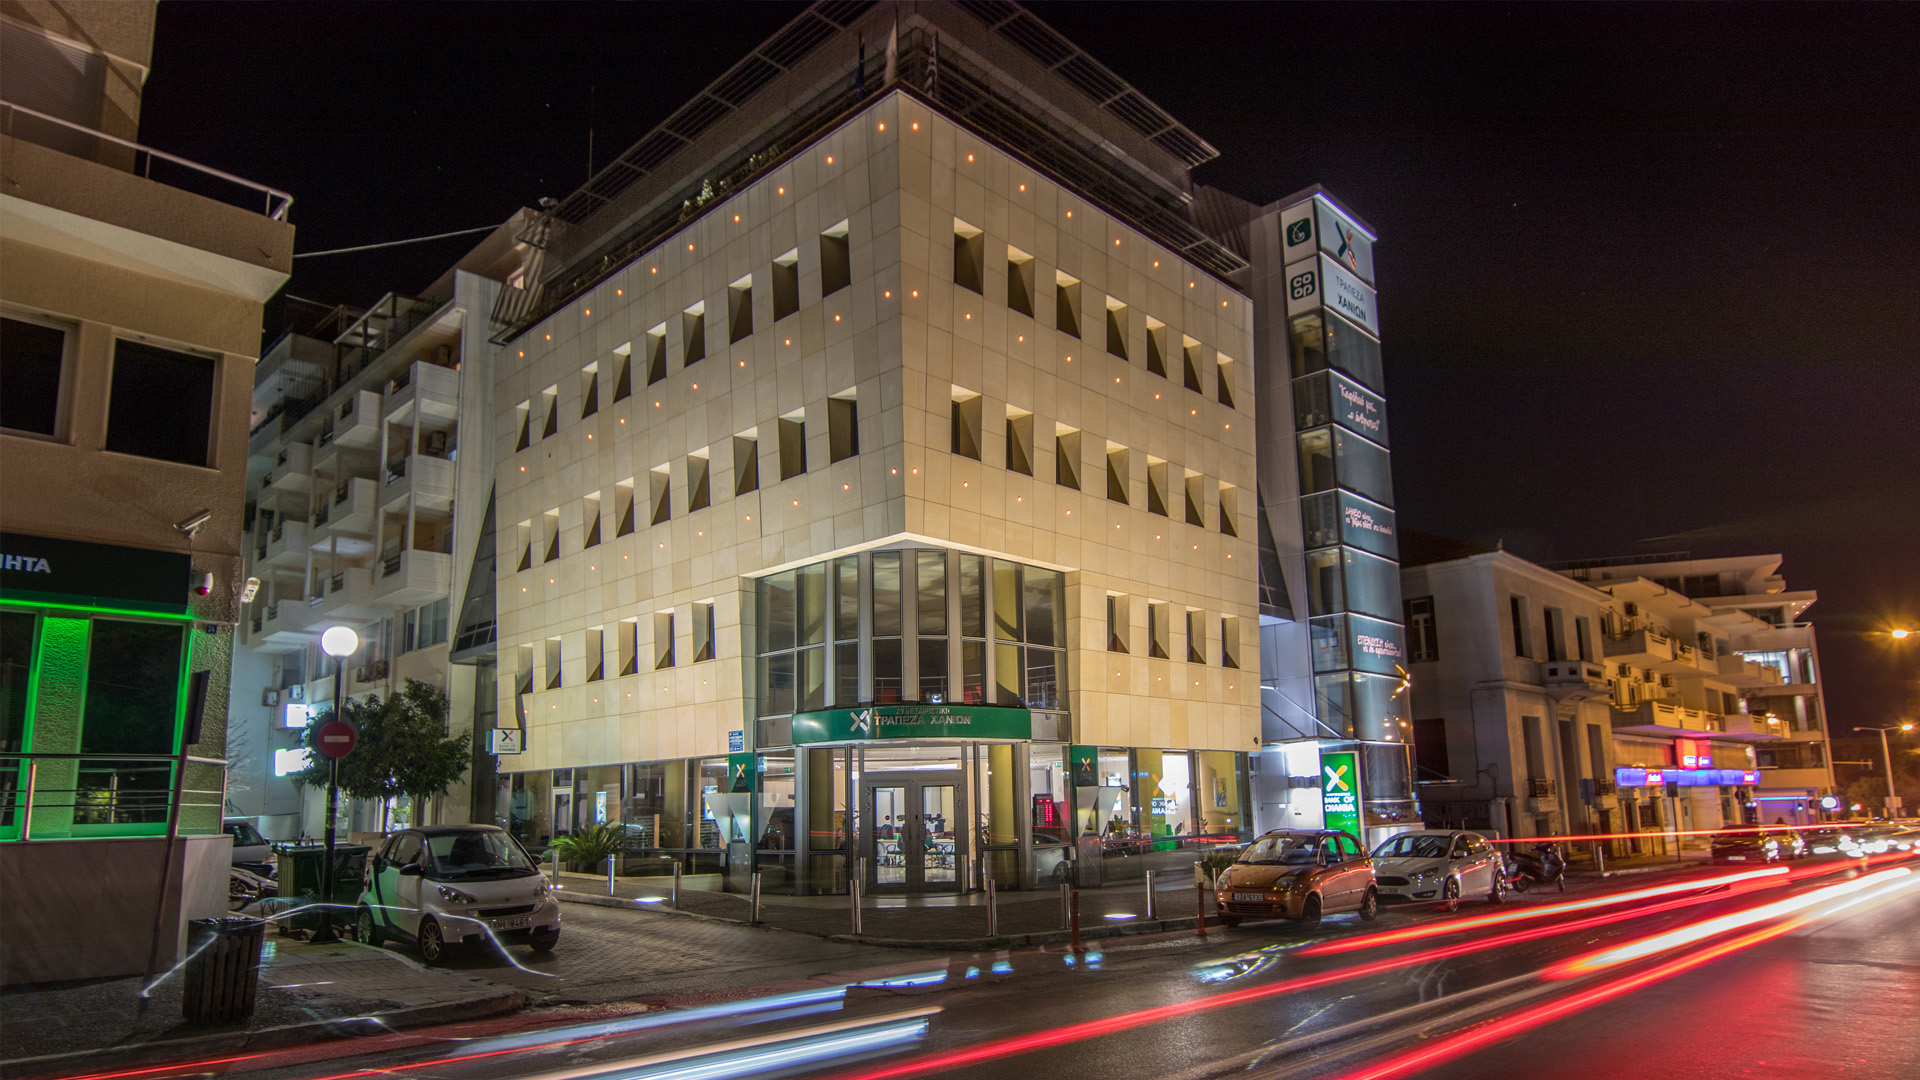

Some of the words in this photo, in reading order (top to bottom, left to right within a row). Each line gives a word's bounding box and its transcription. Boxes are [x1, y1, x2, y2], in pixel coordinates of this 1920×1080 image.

[1336, 275, 1365, 304] ΤΡΑΠΕΖΑ
[1337, 293, 1367, 321] ΧΑΝΙΩΝ
[874, 715, 925, 726] ΤΡΑΠΕΖΑ
[930, 714, 971, 725] ΧΑΝΙΩΝ
[1325, 804, 1356, 812] CHANIA
